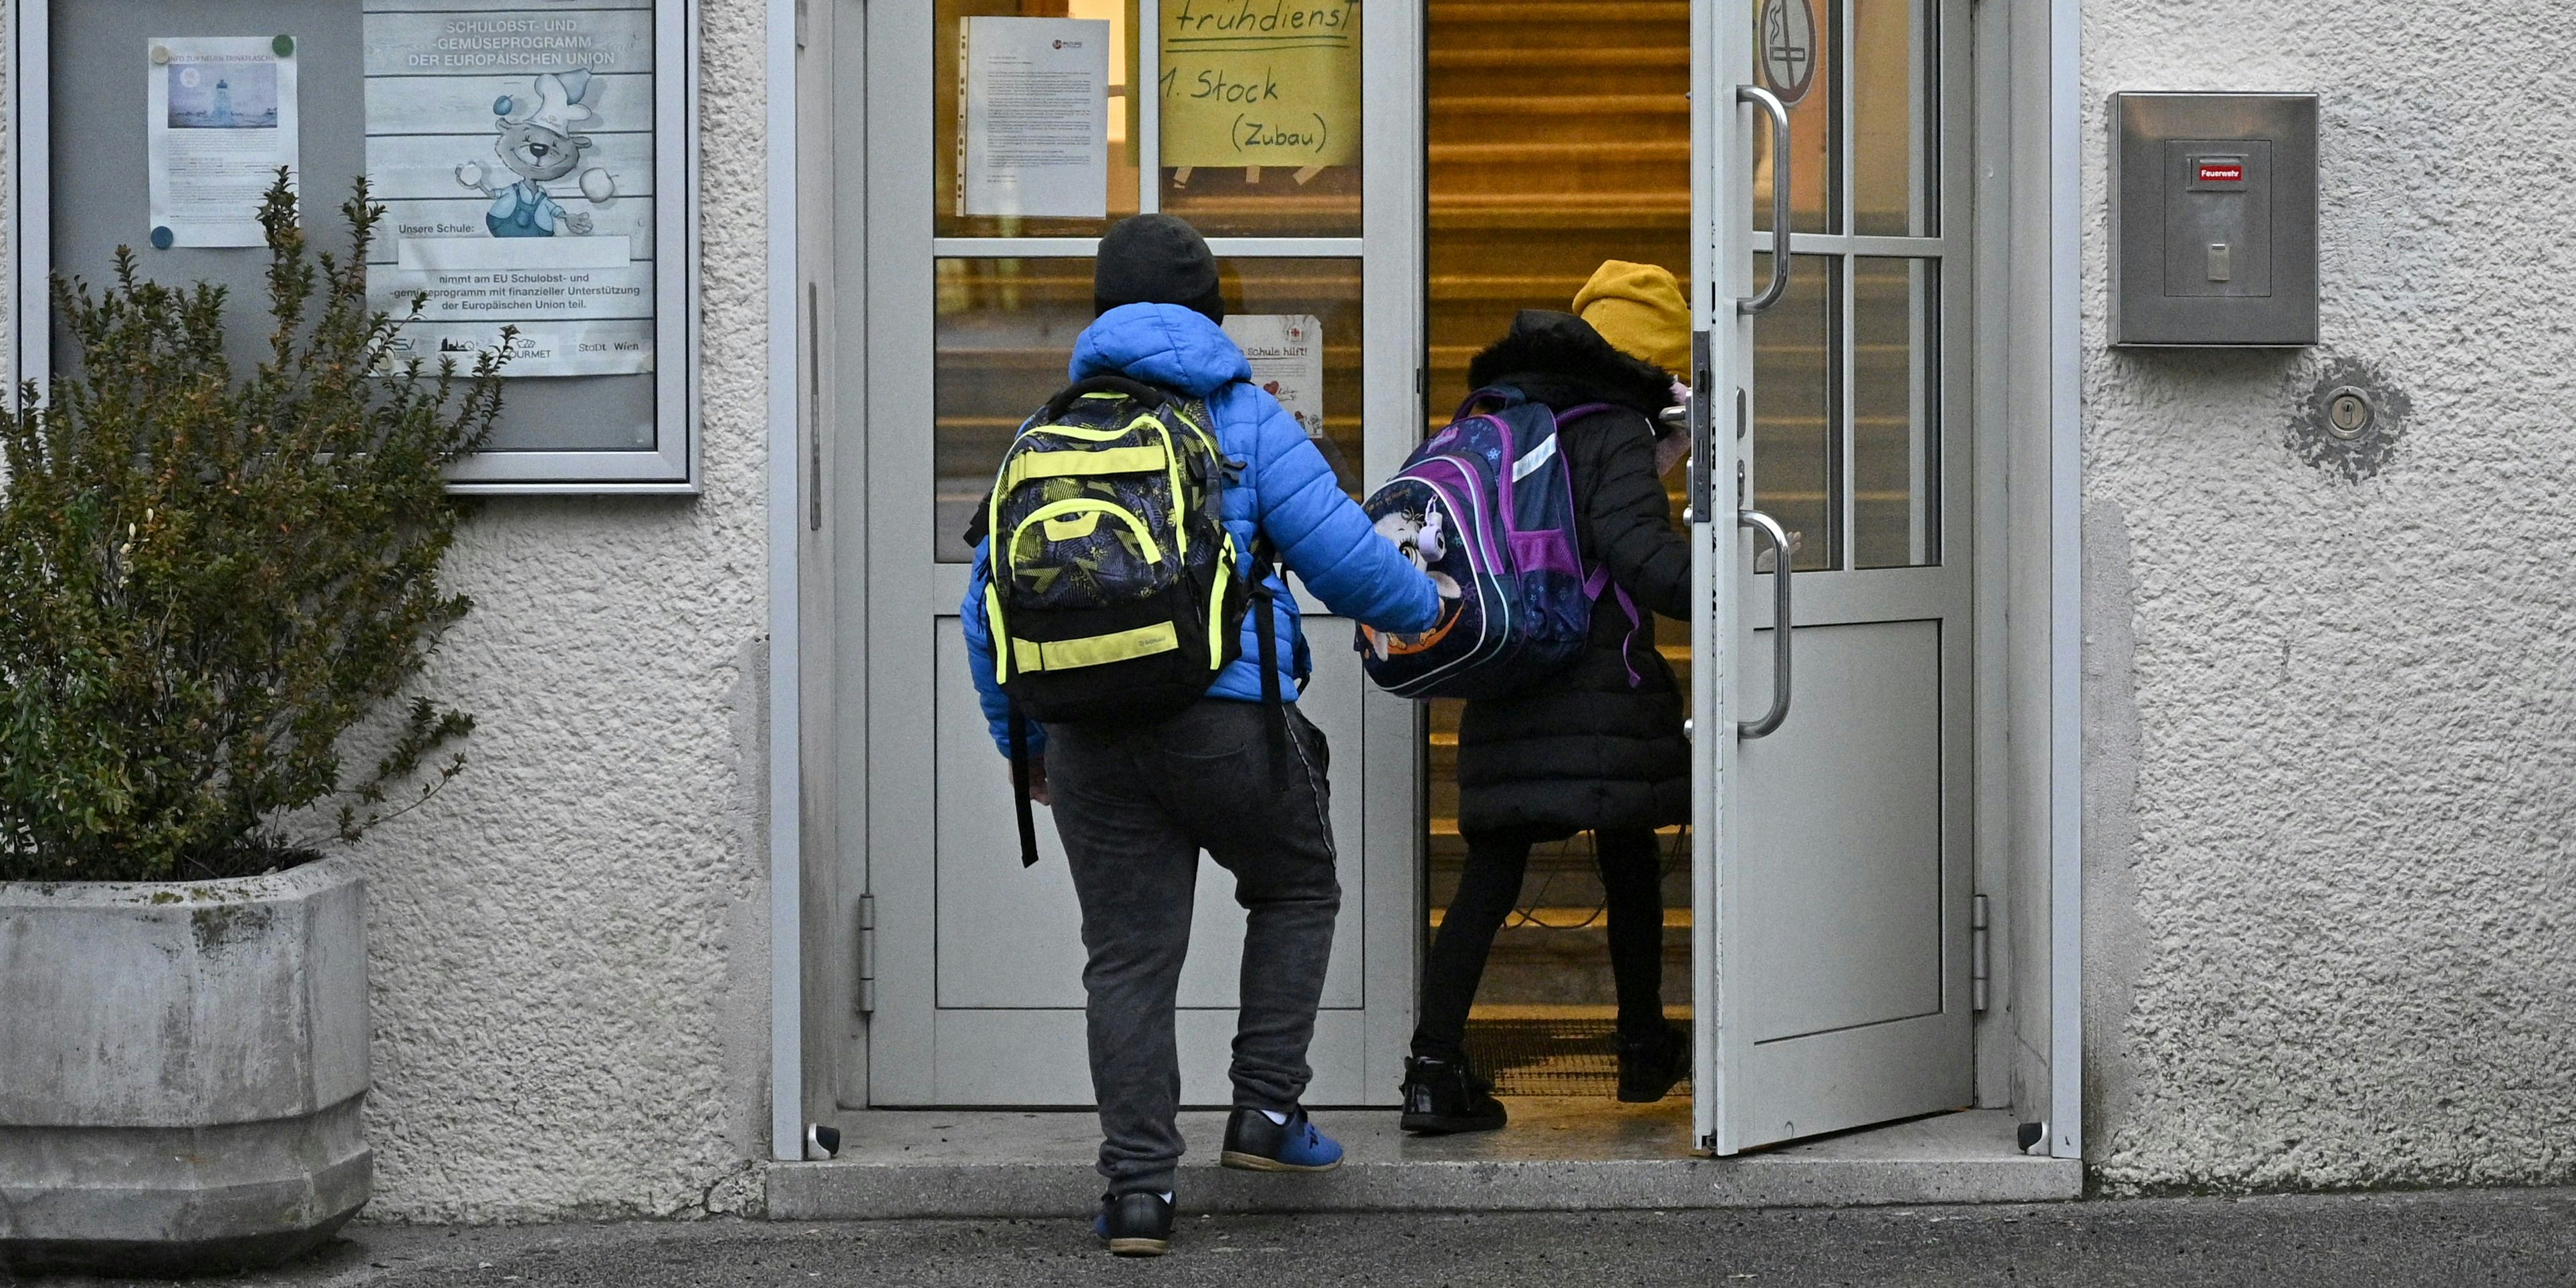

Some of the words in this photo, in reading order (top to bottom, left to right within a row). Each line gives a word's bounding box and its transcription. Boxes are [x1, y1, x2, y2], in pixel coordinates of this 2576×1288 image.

[446, 21, 539, 33] SCHULOBST-
[545, 19, 576, 32] UND
[433, 35, 592, 50] -GEMÜSEPROGRAMM
[408, 54, 439, 66] DER
[445, 51, 561, 66] EUROPÄISCHEN
[568, 53, 614, 65] UNION
[1159, 67, 1179, 98] 1.
[1191, 66, 1278, 103] Stock
[1232, 113, 1326, 153] (Zubau)
[398, 225, 433, 233] Unsere
[437, 224, 474, 233] Schule:
[439, 275, 471, 284] nimmt
[493, 275, 507, 283] EU
[511, 274, 567, 283] Schulobst-
[570, 273, 589, 282] und
[489, 288, 506, 297] mit
[509, 287, 564, 296] finanzieller
[568, 286, 640, 297] Unterstützung
[442, 301, 459, 310] der
[462, 300, 532, 311] Europäischen
[536, 299, 565, 309] Union
[568, 299, 586, 308] teil.
[614, 342, 639, 350] Wien
[1248, 347, 1280, 356] Schule
[1283, 346, 1307, 356] hilft!
[505, 350, 551, 358] OURMET
